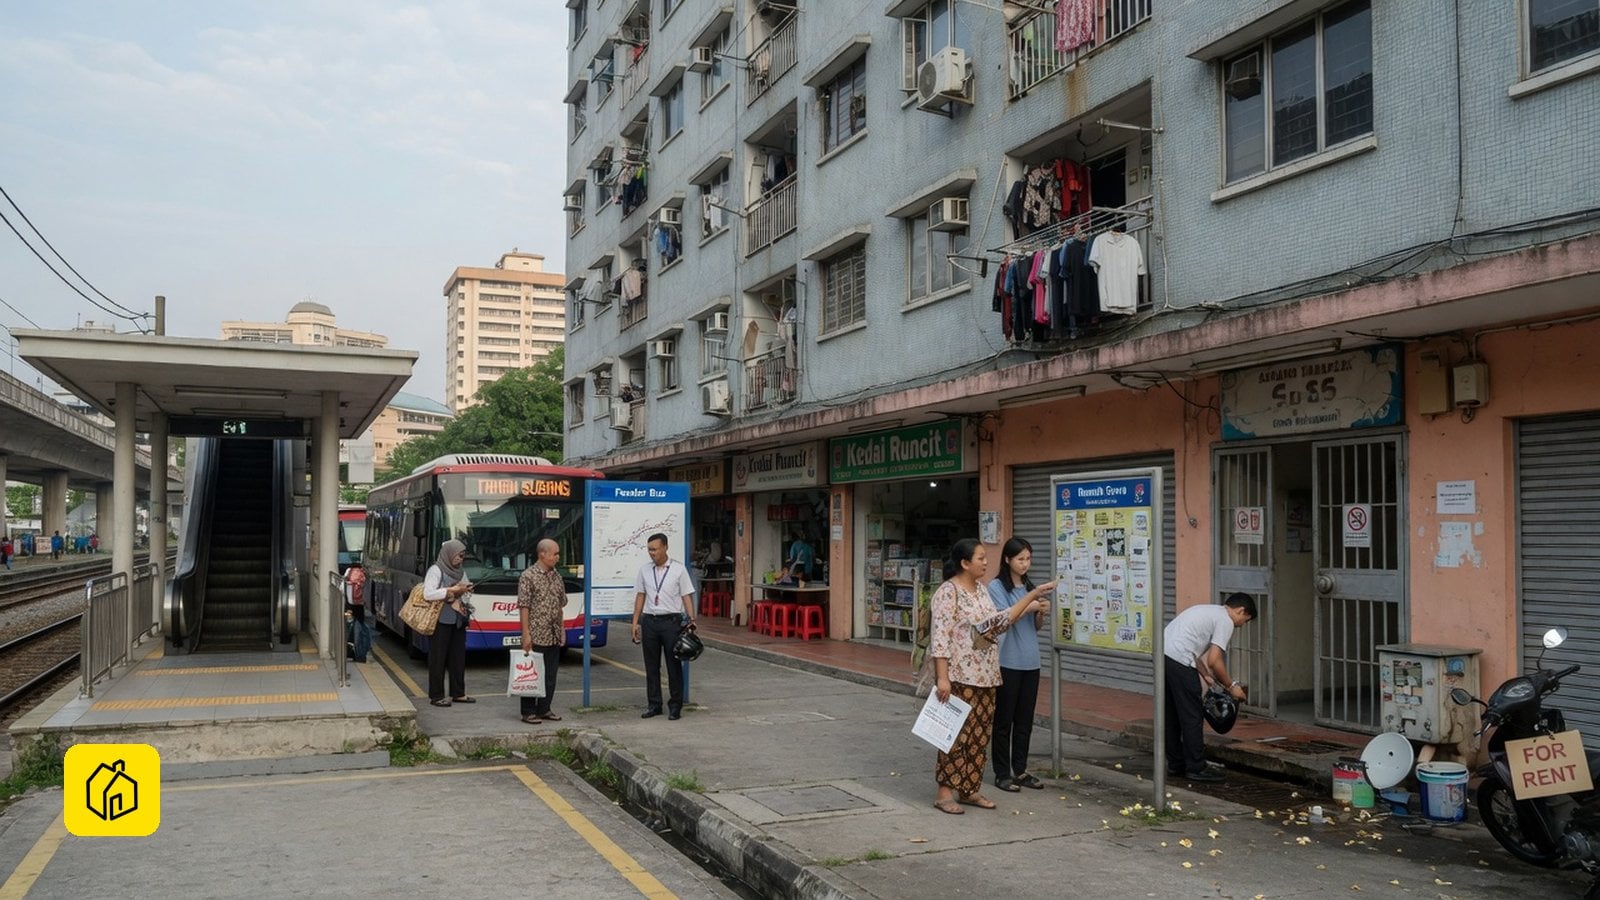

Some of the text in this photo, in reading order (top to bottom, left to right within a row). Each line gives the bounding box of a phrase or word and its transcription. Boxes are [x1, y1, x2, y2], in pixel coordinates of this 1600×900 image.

[847, 429, 942, 467] Kedai Runcit
[1523, 743, 1567, 764] FOR
[1522, 764, 1576, 788] RENT
